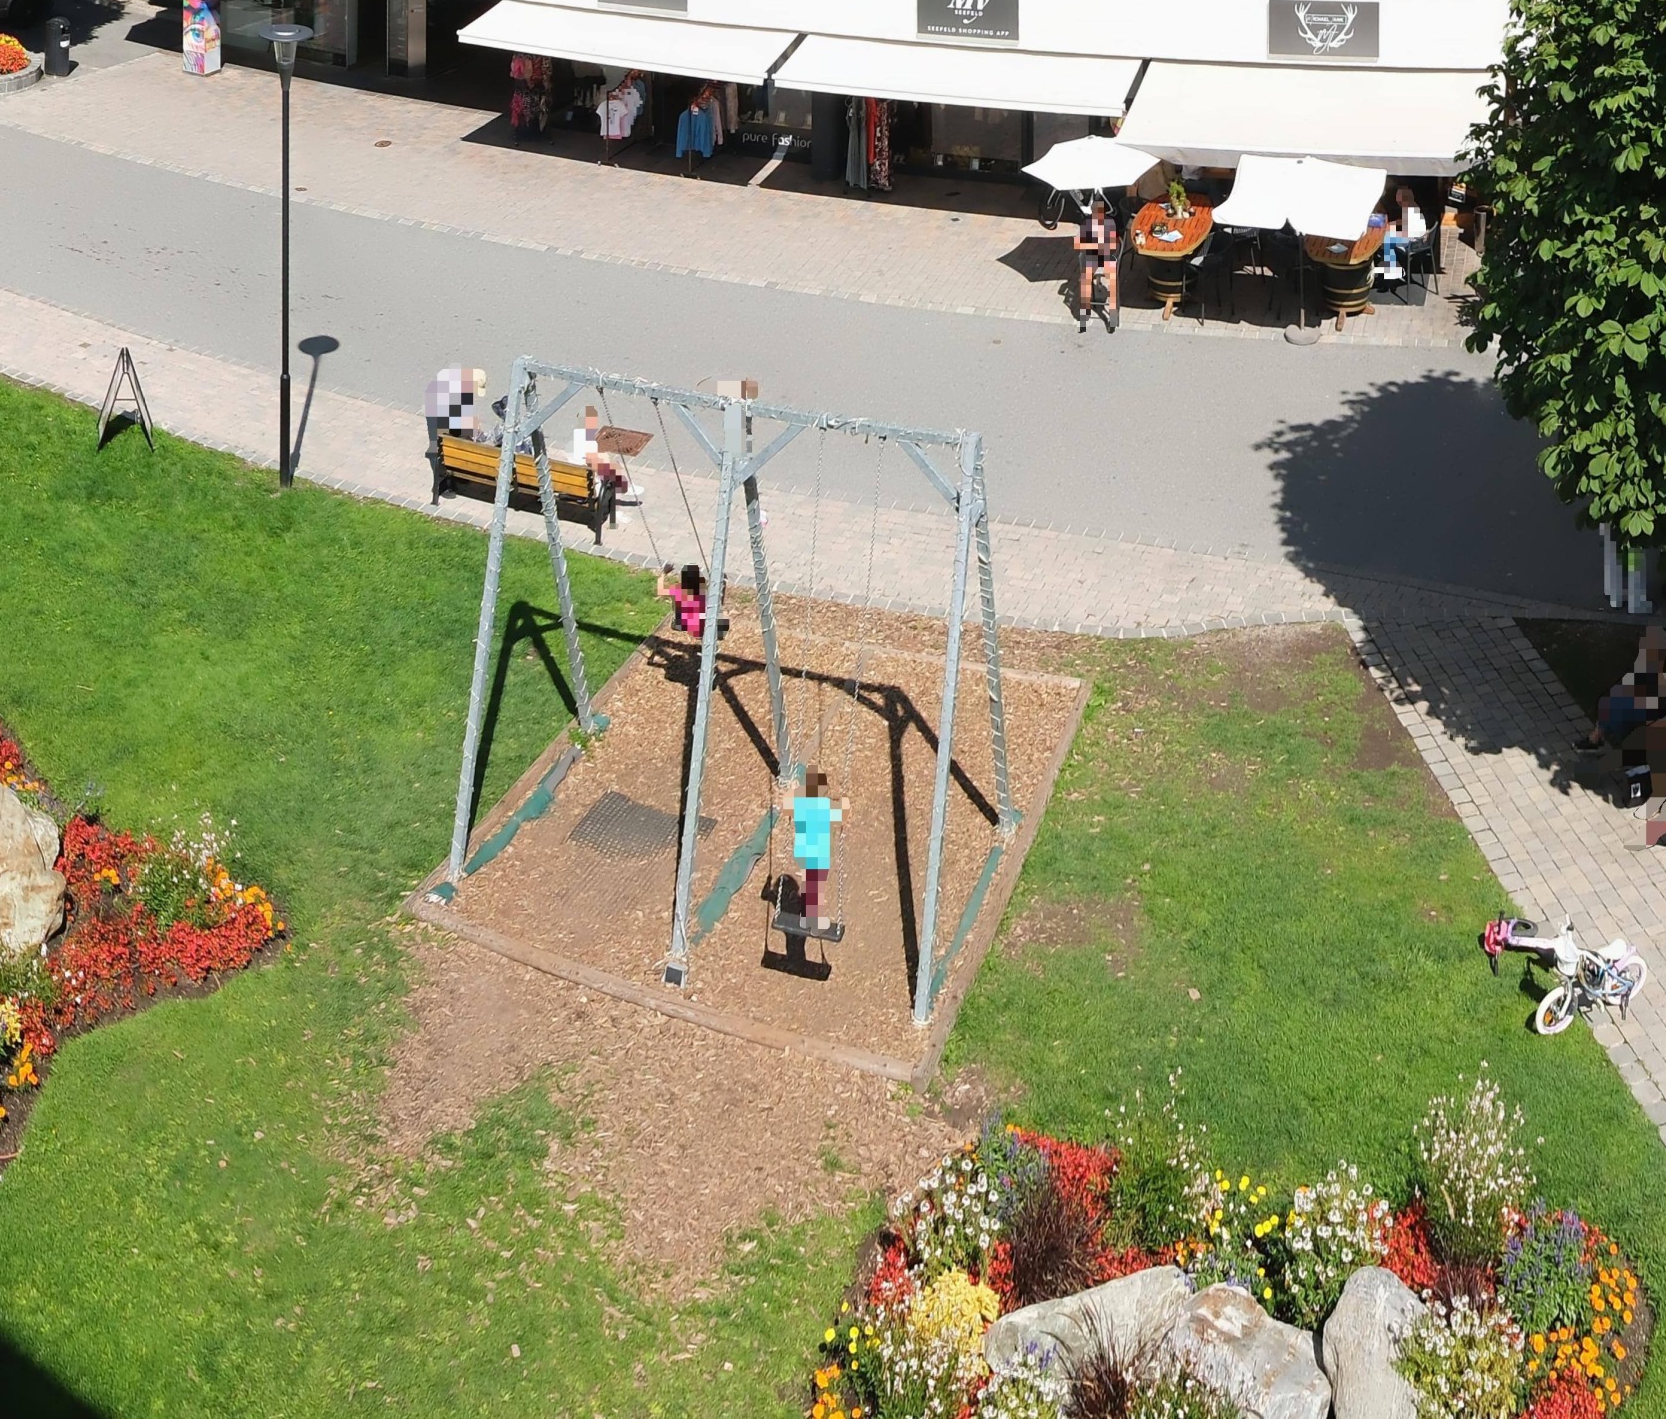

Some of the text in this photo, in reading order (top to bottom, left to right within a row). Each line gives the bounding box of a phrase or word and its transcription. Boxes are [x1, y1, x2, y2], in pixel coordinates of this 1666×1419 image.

[954, 9, 983, 17] SEEFELD
[927, 25, 1010, 37] SEEFELD SHOPPING APP
[743, 132, 768, 147] pure
